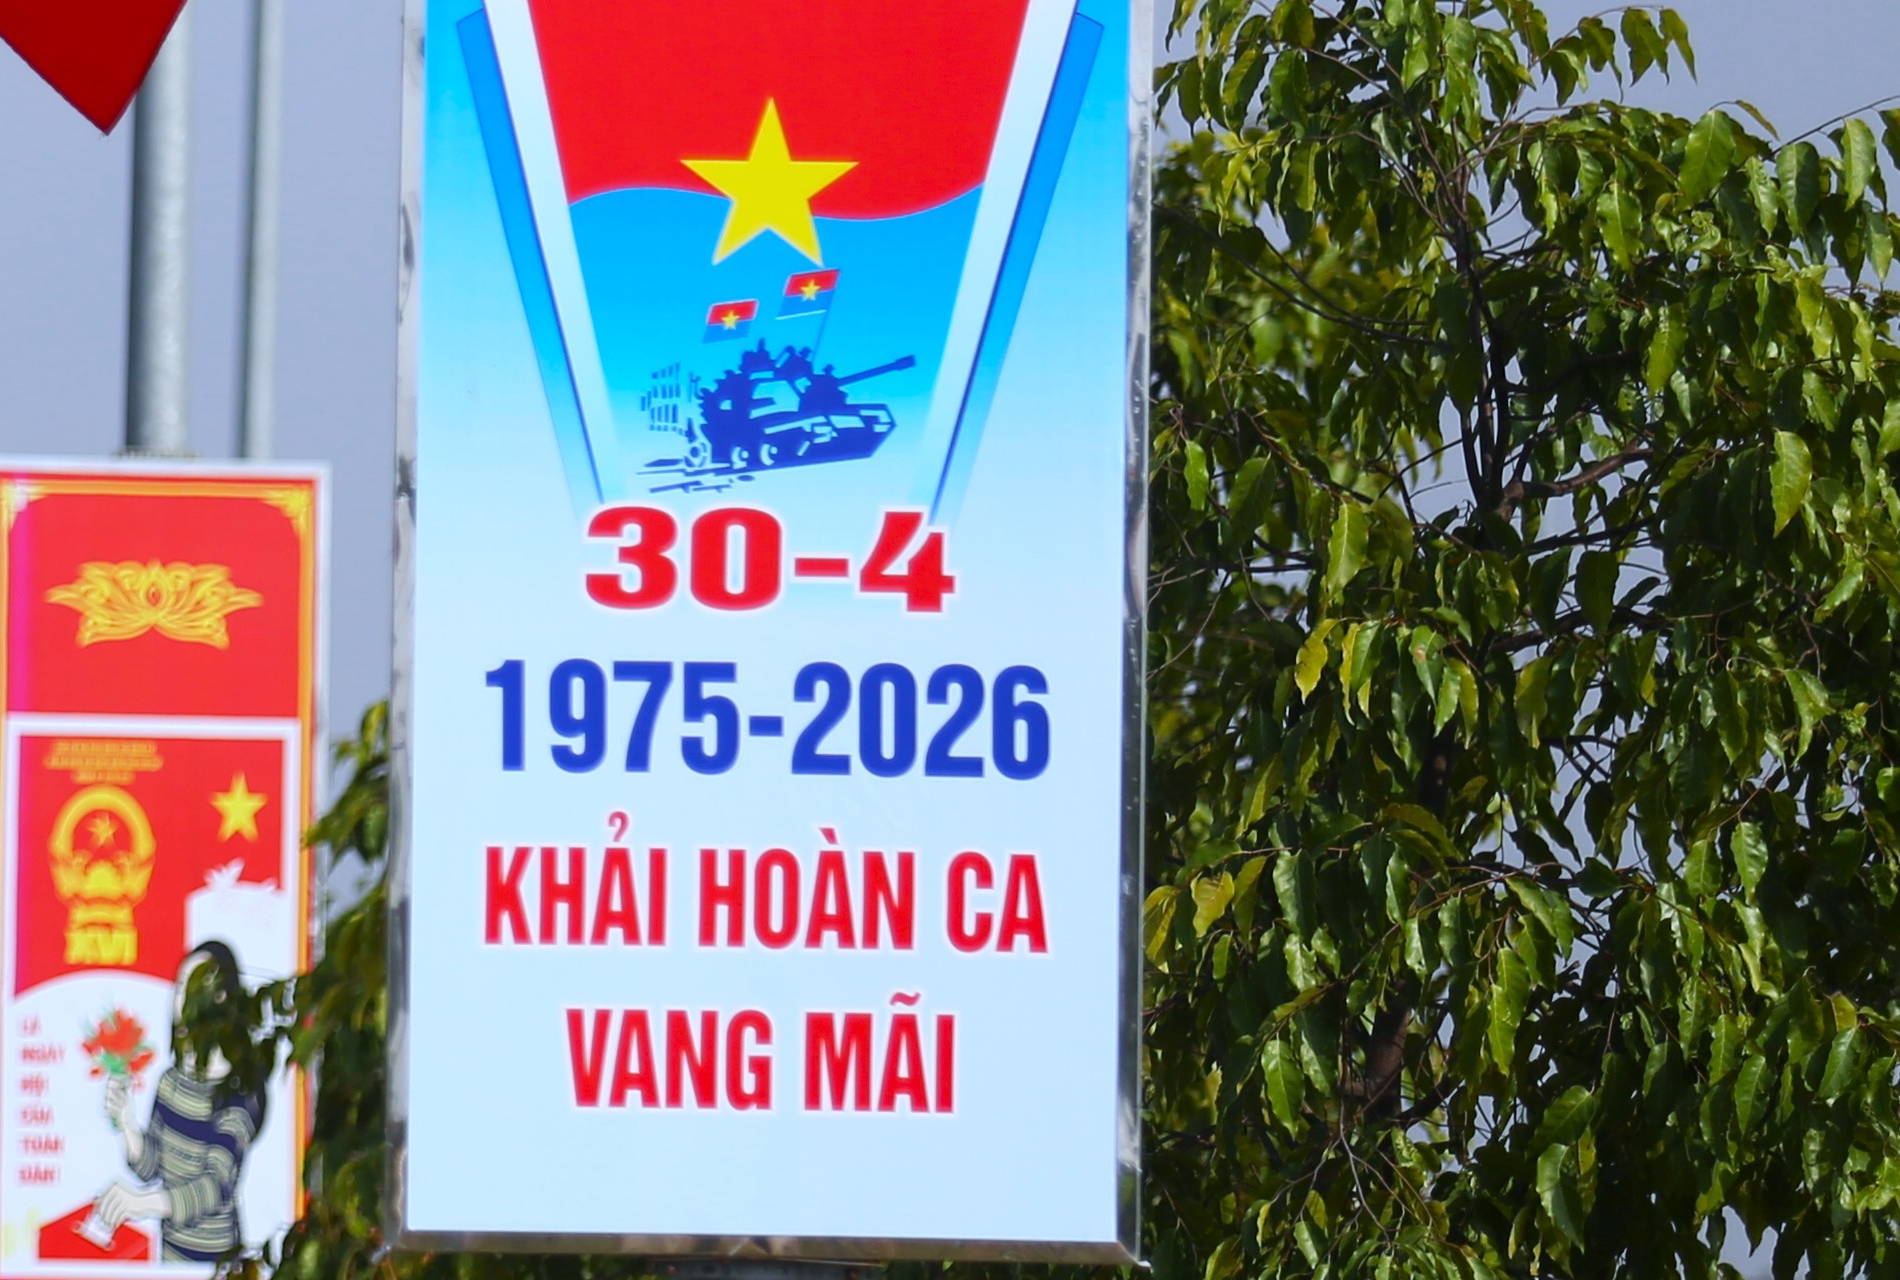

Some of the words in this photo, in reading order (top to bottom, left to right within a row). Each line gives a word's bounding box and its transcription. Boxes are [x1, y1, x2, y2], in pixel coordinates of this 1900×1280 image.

[584, 505, 957, 614] 30-4
[482, 656, 1053, 782] 1975-2026
[483, 810, 668, 947] KHẢI
[698, 826, 916, 951] HOÀN
[946, 850, 1049, 954] CA
[565, 1007, 774, 1112] VANG
[803, 991, 956, 1114] MÃI
